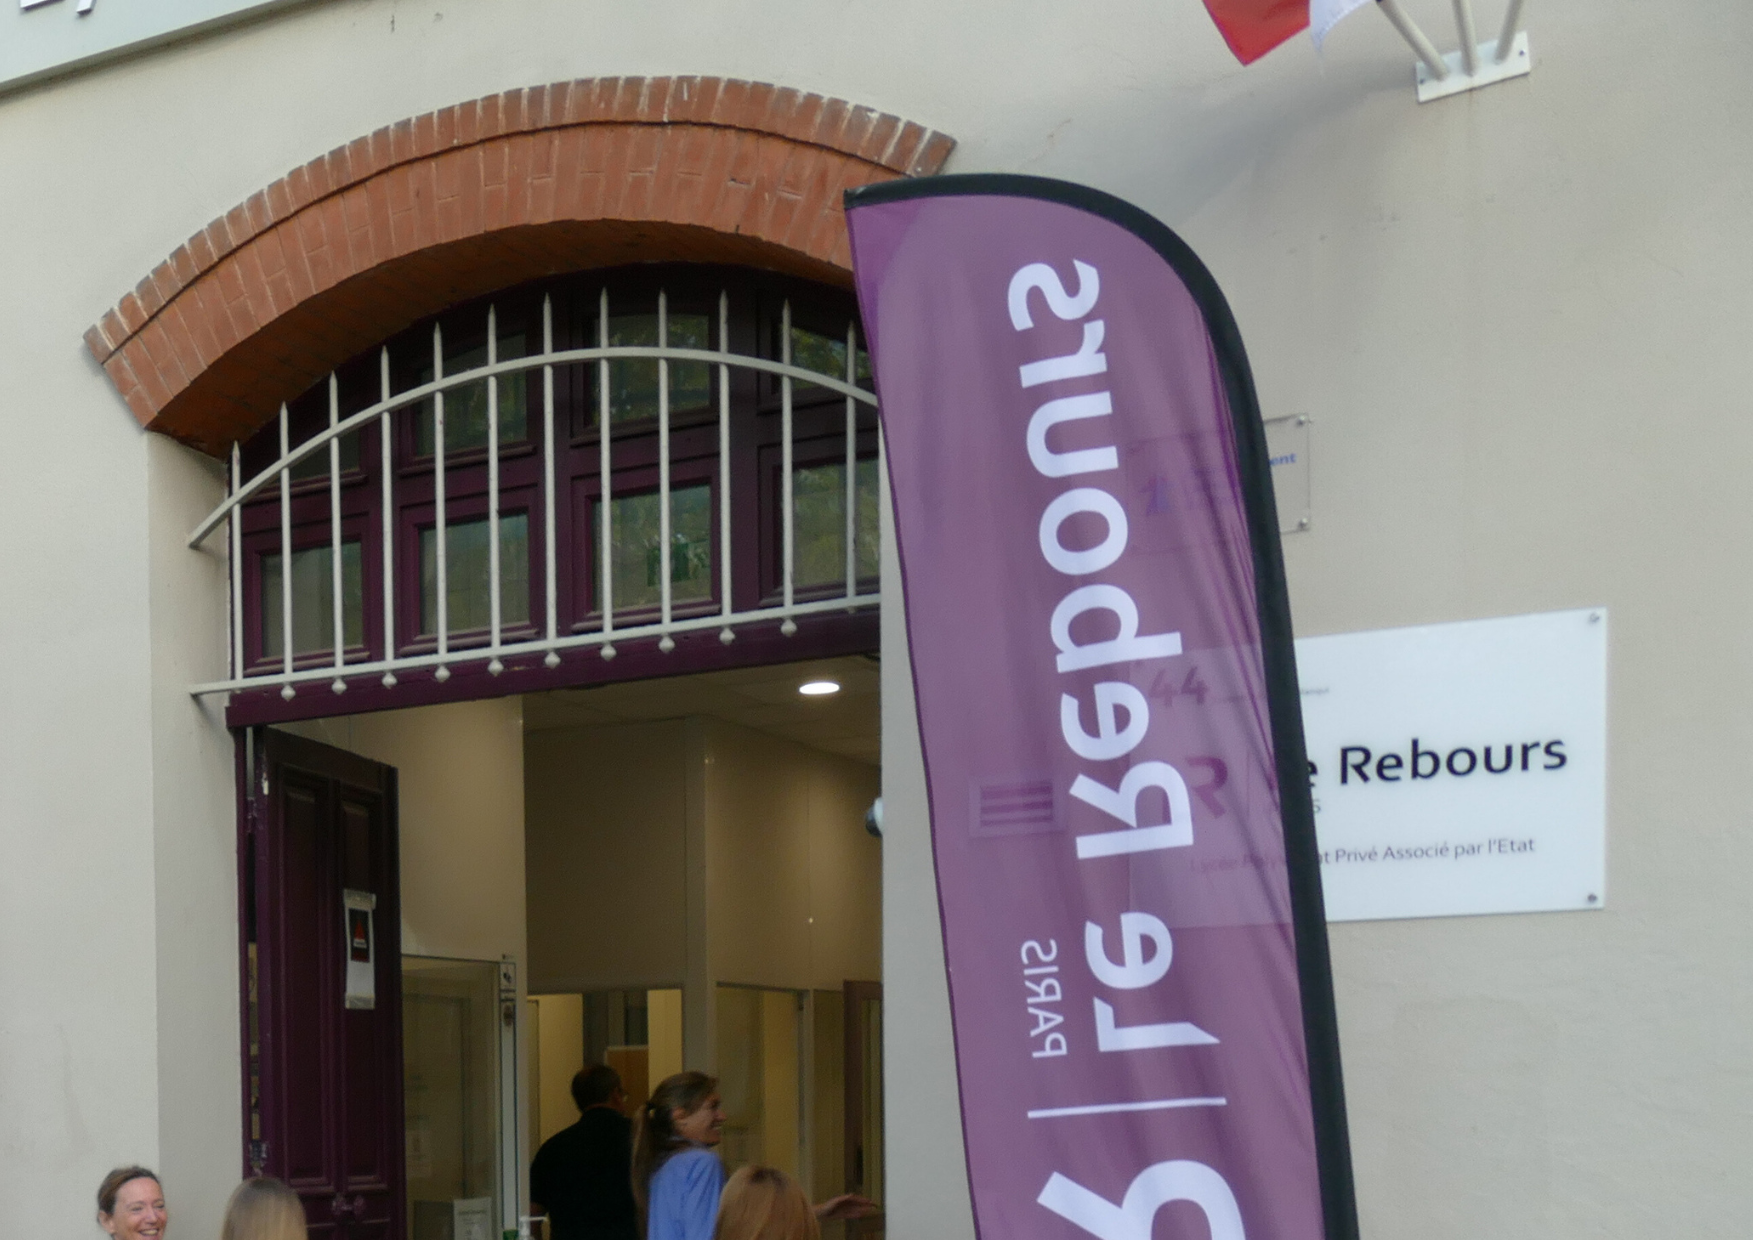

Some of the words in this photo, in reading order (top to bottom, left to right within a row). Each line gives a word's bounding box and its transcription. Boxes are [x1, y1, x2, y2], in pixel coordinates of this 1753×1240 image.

[1340, 738, 1567, 785] Rebours
[1335, 846, 1378, 863] Privé
[1383, 840, 1448, 861] Associé
[1454, 841, 1482, 860] par
[1488, 837, 1535, 854] l'Etat
